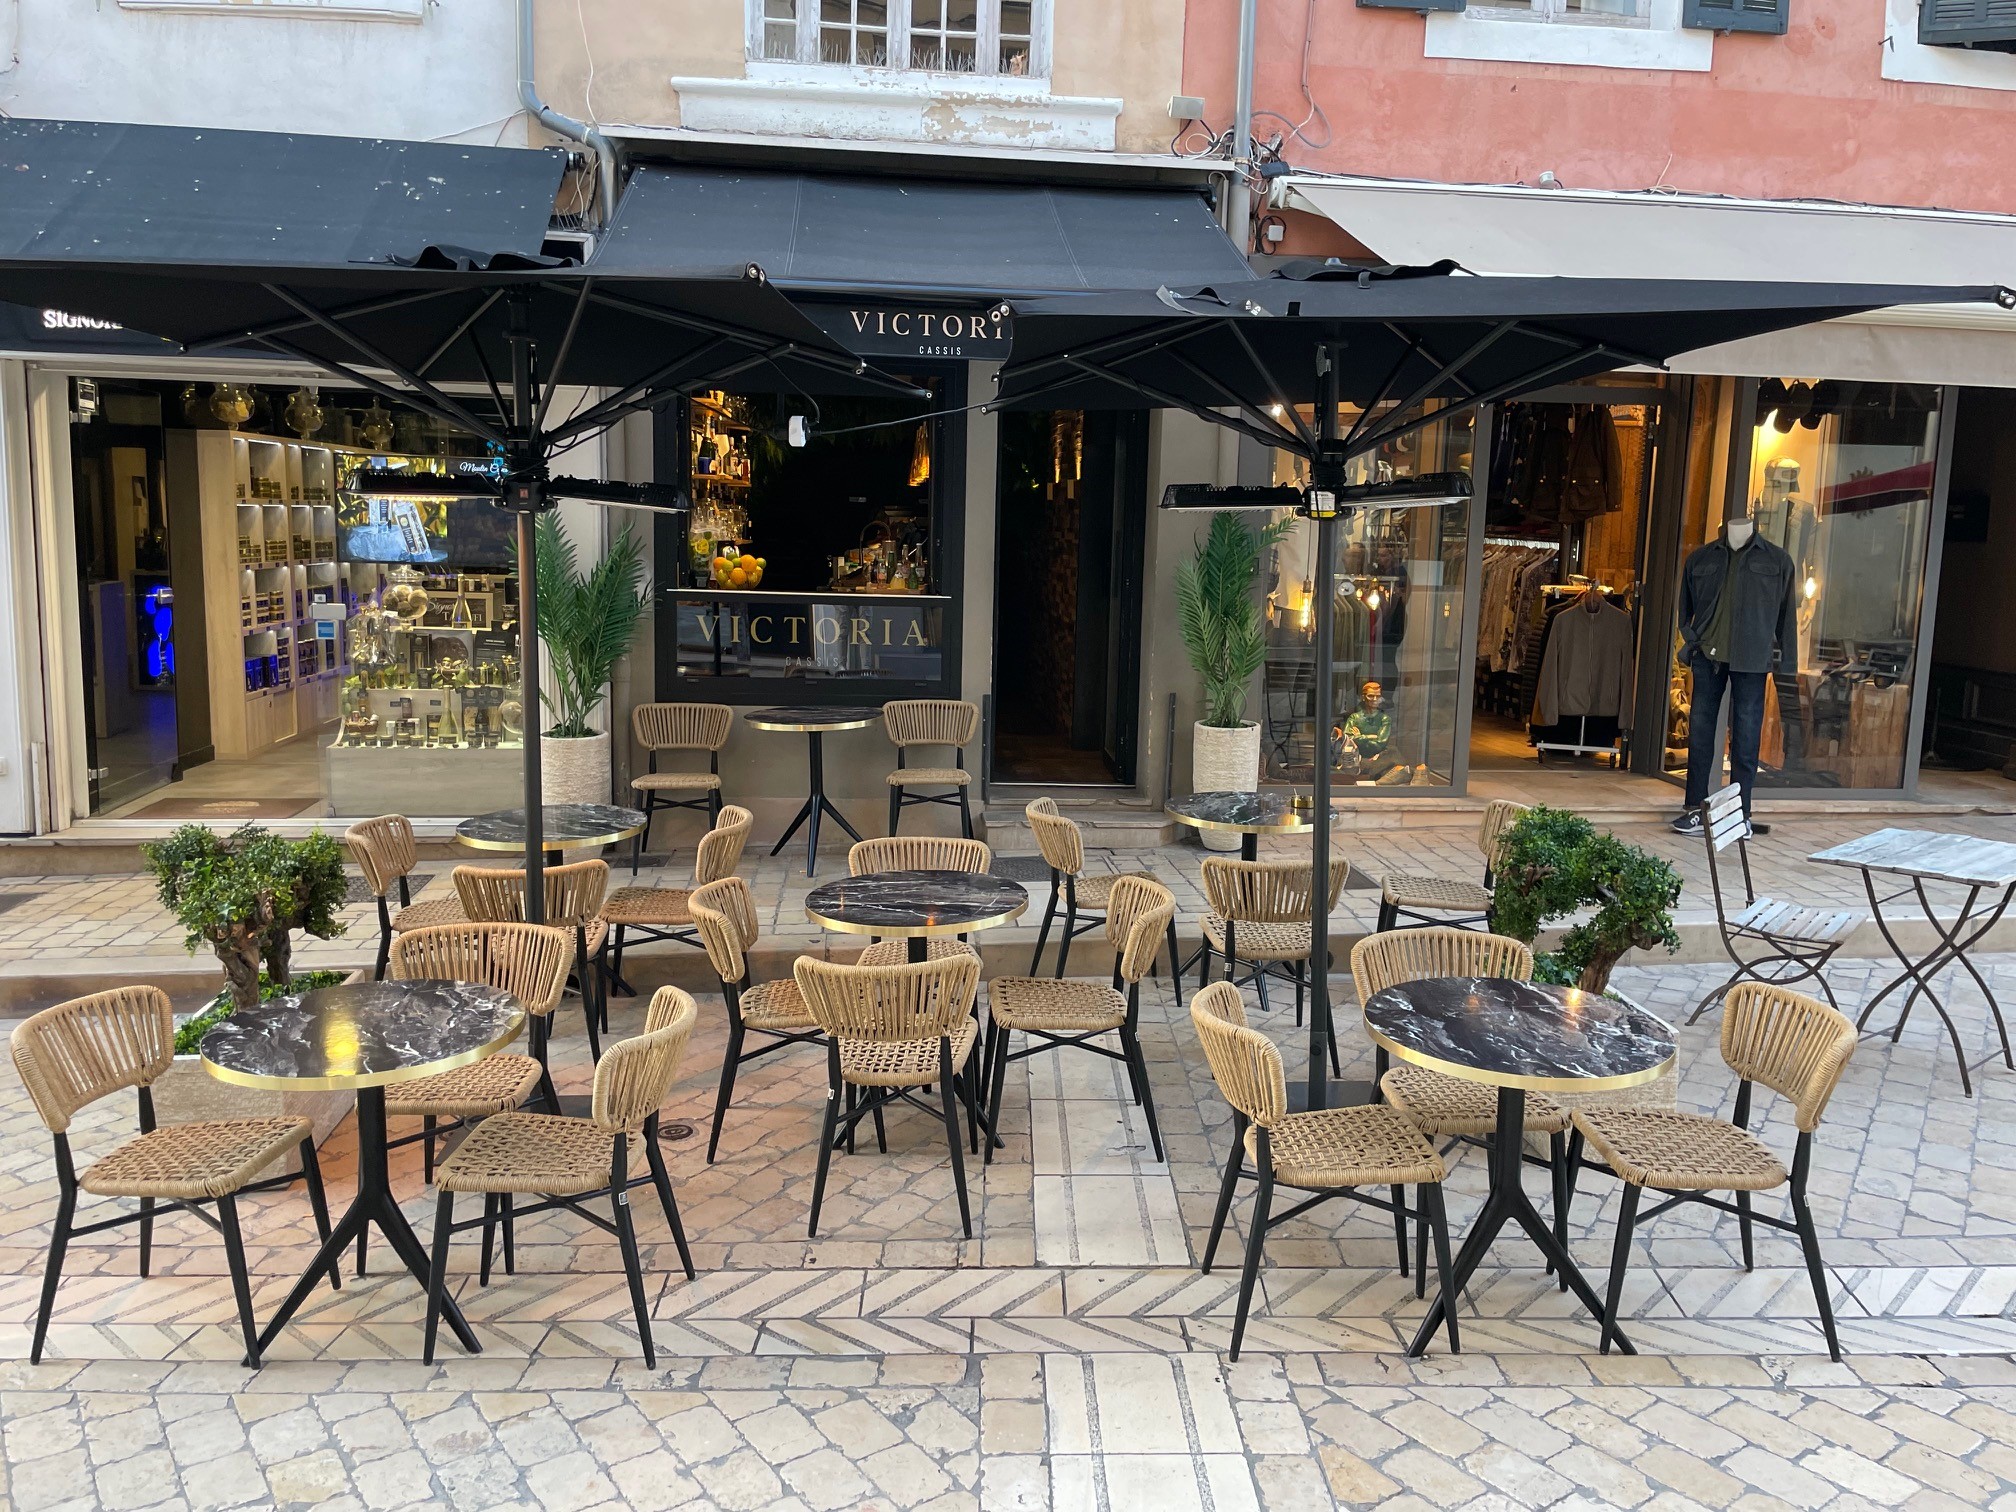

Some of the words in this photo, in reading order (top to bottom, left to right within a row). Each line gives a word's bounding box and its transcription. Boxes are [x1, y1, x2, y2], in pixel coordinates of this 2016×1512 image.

[850, 310, 1013, 340] VICTORI
[919, 345, 962, 356] CASSIS
[695, 614, 927, 647] VICTORIA
[785, 656, 839, 668] CASSIS
